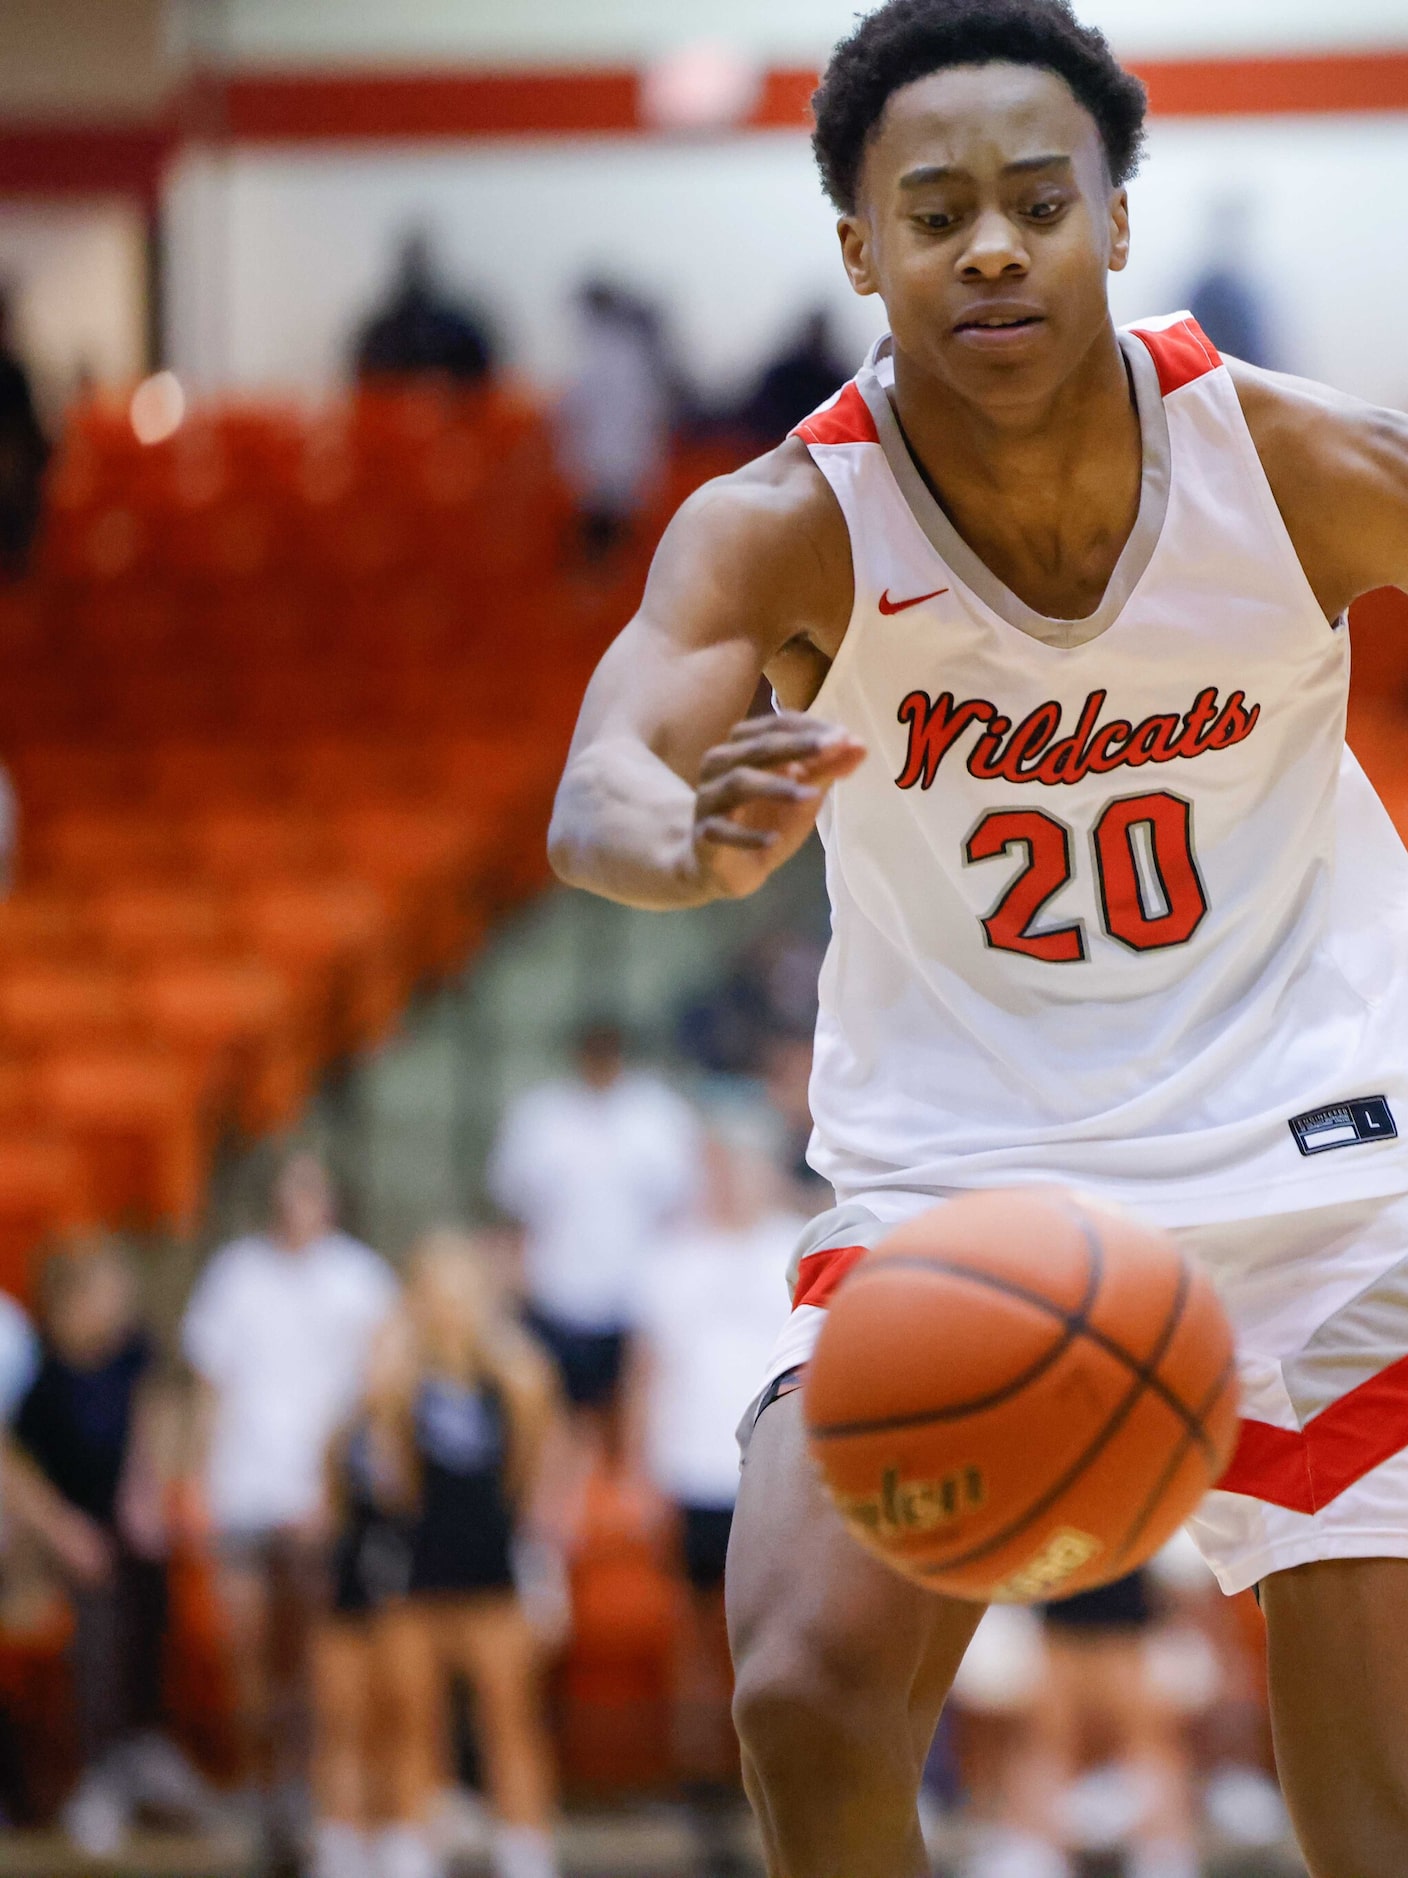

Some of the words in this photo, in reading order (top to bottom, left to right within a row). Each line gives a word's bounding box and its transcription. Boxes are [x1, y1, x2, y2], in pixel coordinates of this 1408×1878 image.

[895, 687, 1260, 790] Wildcats
[961, 789, 1211, 964] 20
[1365, 1111, 1380, 1128] L
